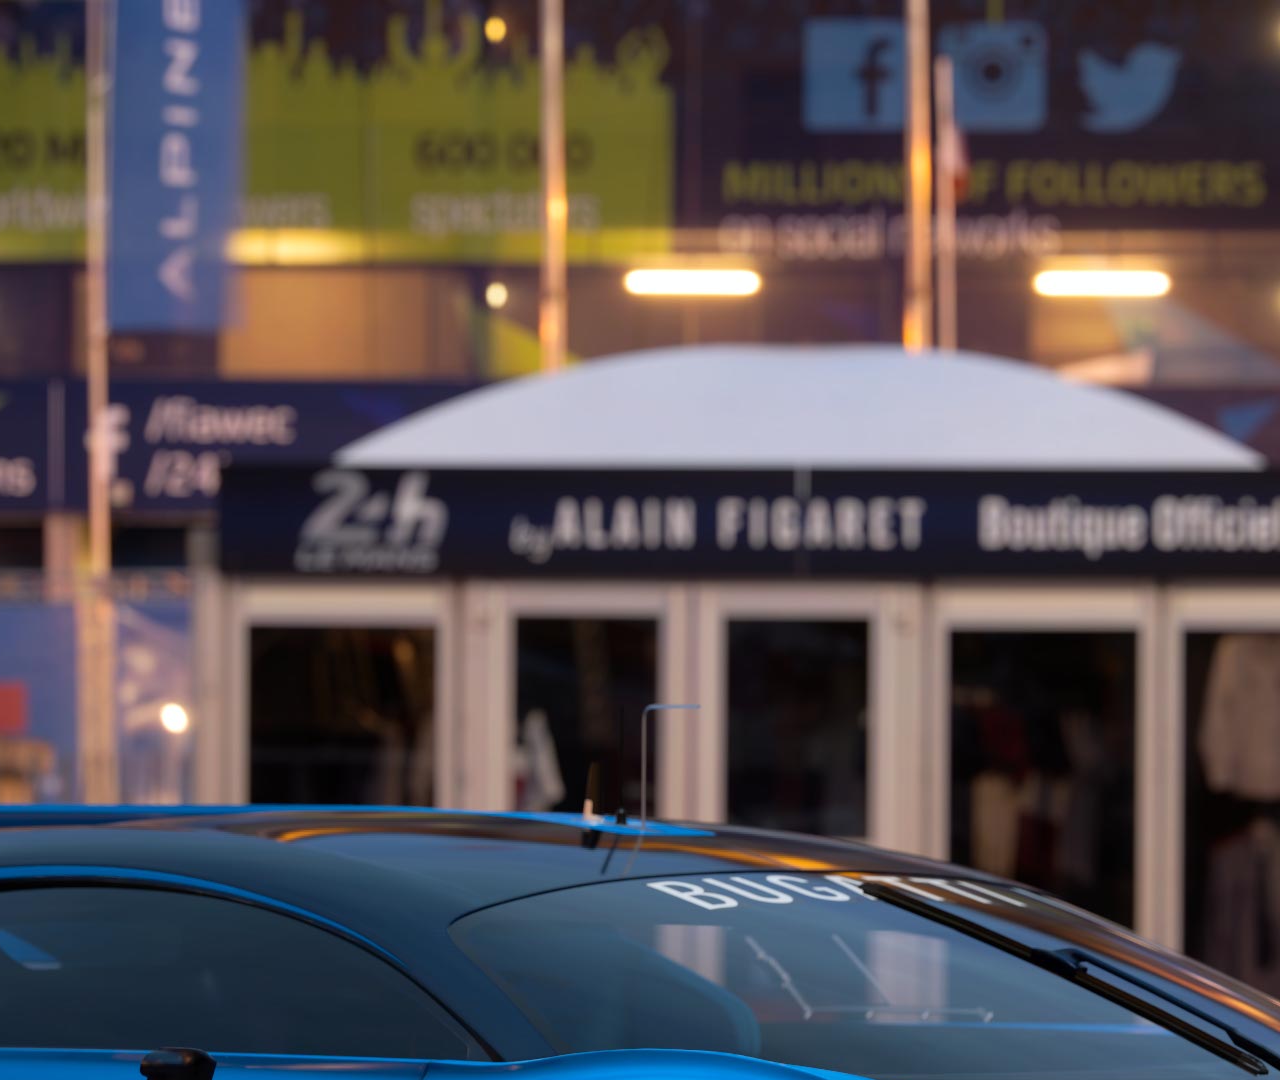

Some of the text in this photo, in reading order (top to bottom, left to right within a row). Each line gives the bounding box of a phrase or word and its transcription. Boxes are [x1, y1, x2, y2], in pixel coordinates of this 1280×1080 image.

[158, 0, 201, 300] ALPINE
[724, 159, 912, 206] MILLION
[1004, 160, 1269, 207] FOLLOWERS
[410, 187, 600, 236] spectatrs
[888, 208, 1062, 260] nworks
[144, 394, 298, 446] /fiawec
[551, 496, 697, 551] ALAIN
[718, 496, 928, 551] FIGARET
[976, 493, 1147, 561] Boutique
[646, 873, 1029, 912] BUGATTI
